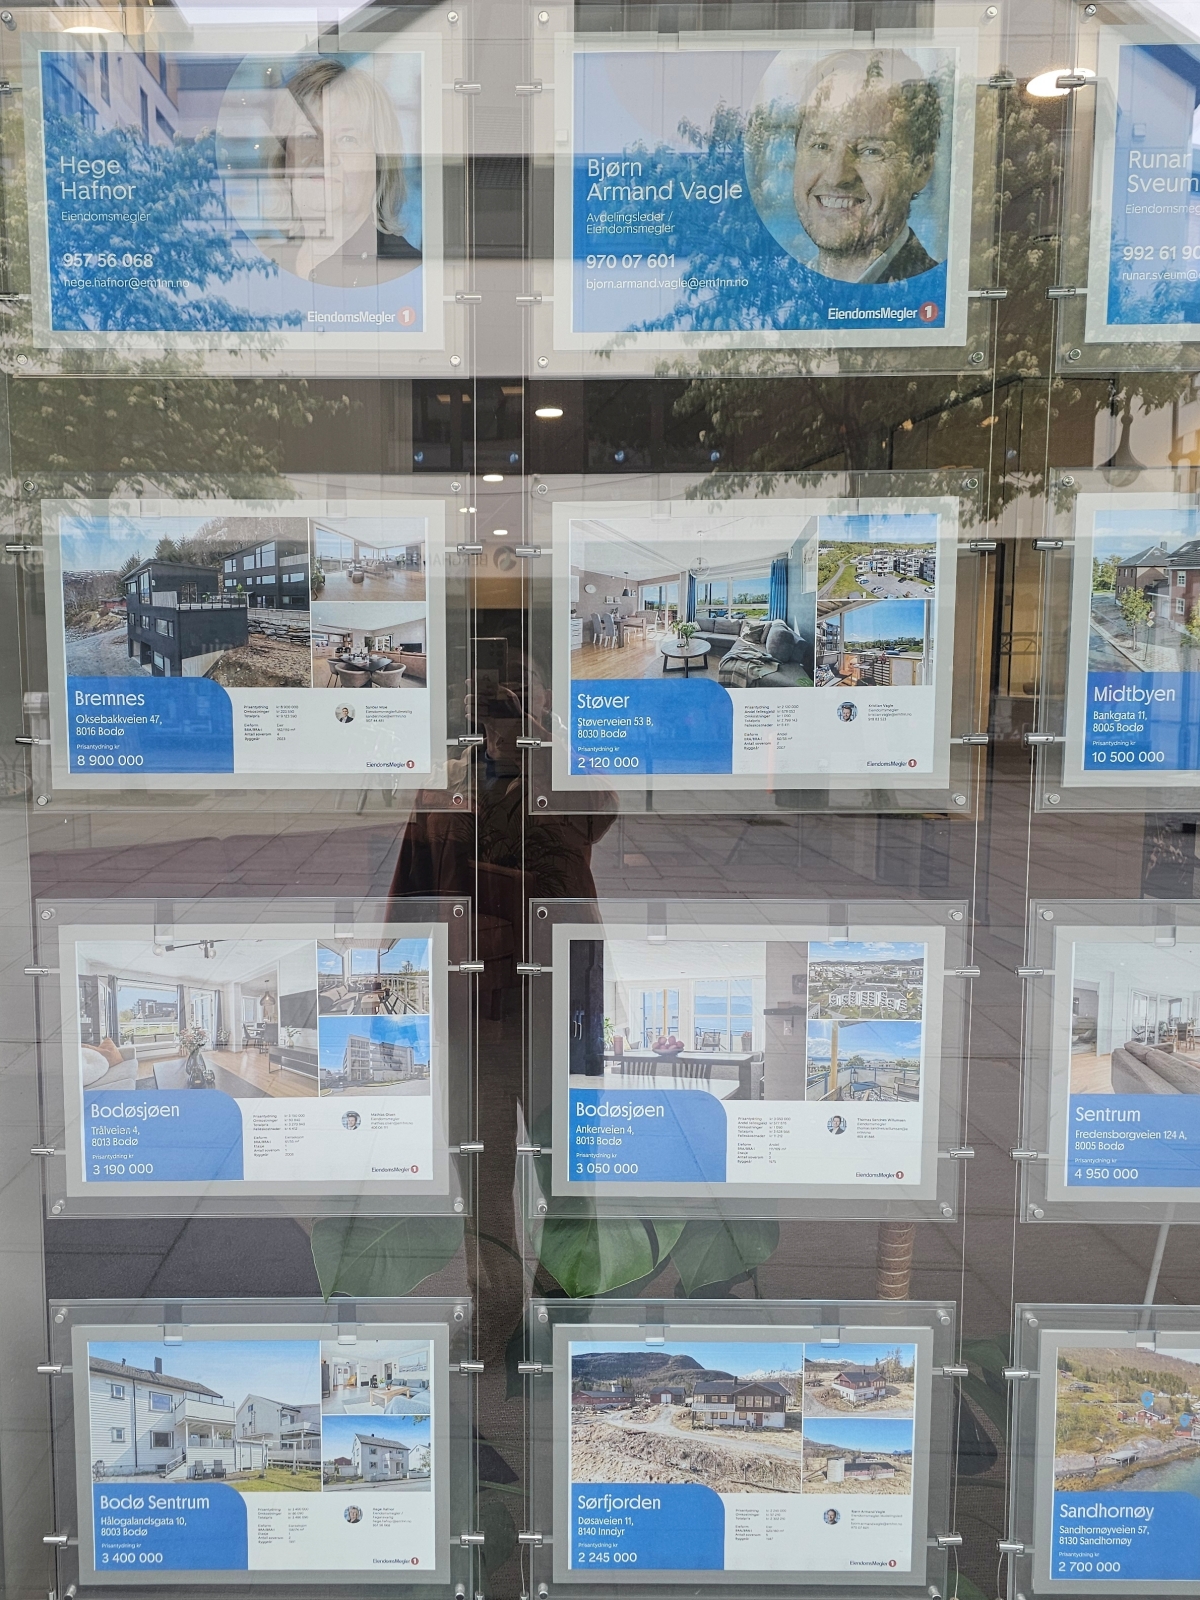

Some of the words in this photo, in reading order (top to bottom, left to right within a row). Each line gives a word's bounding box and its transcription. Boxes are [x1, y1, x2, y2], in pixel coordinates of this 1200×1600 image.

[1129, 150, 1192, 169] Runar
[60, 155, 120, 179] Hege
[588, 157, 642, 182] Bjørn
[1127, 174, 1200, 193] Sveum
[61, 180, 136, 200] Hafnor
[586, 180, 673, 201] Armand
[679, 179, 743, 204] Vagle
[61, 211, 151, 224] Eiendomsmegler
[586, 211, 665, 224] Avdelingsleder
[586, 224, 675, 236] Eiendomsmegler
[1123, 246, 1154, 260] 992
[1159, 246, 1176, 260] 61
[63, 253, 93, 268] 957
[97, 253, 117, 268] 56
[122, 253, 153, 268] 068
[586, 254, 617, 269] 970
[621, 254, 643, 269] 07
[647, 253, 675, 268] 601
[1122, 269, 1200, 282] runar.sveum@
[307, 311, 396, 325] EiendomsMegler
[827, 307, 918, 321] EiendomsMegler
[75, 691, 145, 706] Bremnes
[1094, 685, 1175, 705] Midtbyen
[577, 693, 630, 709] Støver
[76, 715, 148, 724] Oksebakkveien
[150, 715, 162, 726] 47,
[1093, 711, 1135, 721] Bankgata
[1138, 711, 1147, 720] 11,
[577, 717, 631, 727] Støverveien
[633, 717, 644, 726] 53
[646, 717, 654, 727] B,
[1093, 723, 1115, 732] 8005
[1117, 723, 1144, 732] Bodø
[76, 727, 96, 736] 8016
[98, 727, 125, 736] Bodø
[577, 729, 598, 738] 8030
[600, 729, 627, 738] Bodø
[77, 755, 86, 766] 8
[89, 755, 114, 766] 900
[118, 755, 144, 766] 000
[578, 757, 586, 768] 2
[589, 757, 610, 768] 120
[614, 757, 639, 767] 000
[1092, 752, 1106, 762] 10
[1110, 752, 1135, 762] 500
[1138, 752, 1165, 762] 000
[91, 1102, 180, 1121] Bodøsjøen
[576, 1101, 665, 1121] Bodøsjøen
[1075, 1106, 1141, 1122] Sentrum
[91, 1125, 131, 1135] Trålveien
[133, 1125, 140, 1135] 4,
[576, 1125, 624, 1134] Ankerveien
[627, 1125, 634, 1135] 4,
[1075, 1130, 1161, 1141] Fredensborgveien
[1163, 1131, 1177, 1139] 124
[1178, 1131, 1187, 1140] A,
[91, 1138, 111, 1146] 8013
[113, 1137, 139, 1146] Bodø
[576, 1136, 595, 1145] 8013
[597, 1136, 622, 1145] Bodø
[1075, 1142, 1096, 1150] 8005
[1098, 1142, 1124, 1150] Bodø
[93, 1164, 100, 1175] 3
[103, 1164, 125, 1174] 190
[129, 1163, 154, 1174] 000
[576, 1163, 583, 1174] 3
[587, 1163, 610, 1173] 050
[614, 1163, 638, 1173] 000
[1074, 1169, 1082, 1179] 4
[1086, 1169, 1109, 1179] 950
[1113, 1169, 1138, 1179] 000
[100, 1494, 144, 1510] Bodø
[148, 1495, 210, 1510] Sentrum
[577, 1494, 661, 1513] Sørfjorden
[1060, 1503, 1154, 1521] Sandhornøy
[101, 1516, 174, 1527] Hålogalandsgata
[175, 1516, 187, 1526] 10,
[578, 1516, 623, 1525] Døsaveien
[625, 1517, 634, 1526] 11,
[101, 1528, 121, 1536] 8003
[123, 1527, 148, 1536] Bodø
[578, 1527, 596, 1536] 8140
[598, 1527, 625, 1538] Inndyr
[1059, 1525, 1136, 1536] Sandhornøyveien
[1137, 1526, 1150, 1535] 57,
[1059, 1537, 1078, 1545] 8130
[1079, 1536, 1132, 1547] Sandhornøy
[102, 1553, 109, 1563] 3
[112, 1553, 136, 1563] 400
[139, 1553, 163, 1563] 000
[578, 1552, 585, 1563] 2
[589, 1552, 610, 1563] 245
[613, 1552, 637, 1562] 000
[1058, 1562, 1066, 1572] 2
[1069, 1562, 1093, 1572] 700
[1096, 1562, 1120, 1572] 000
